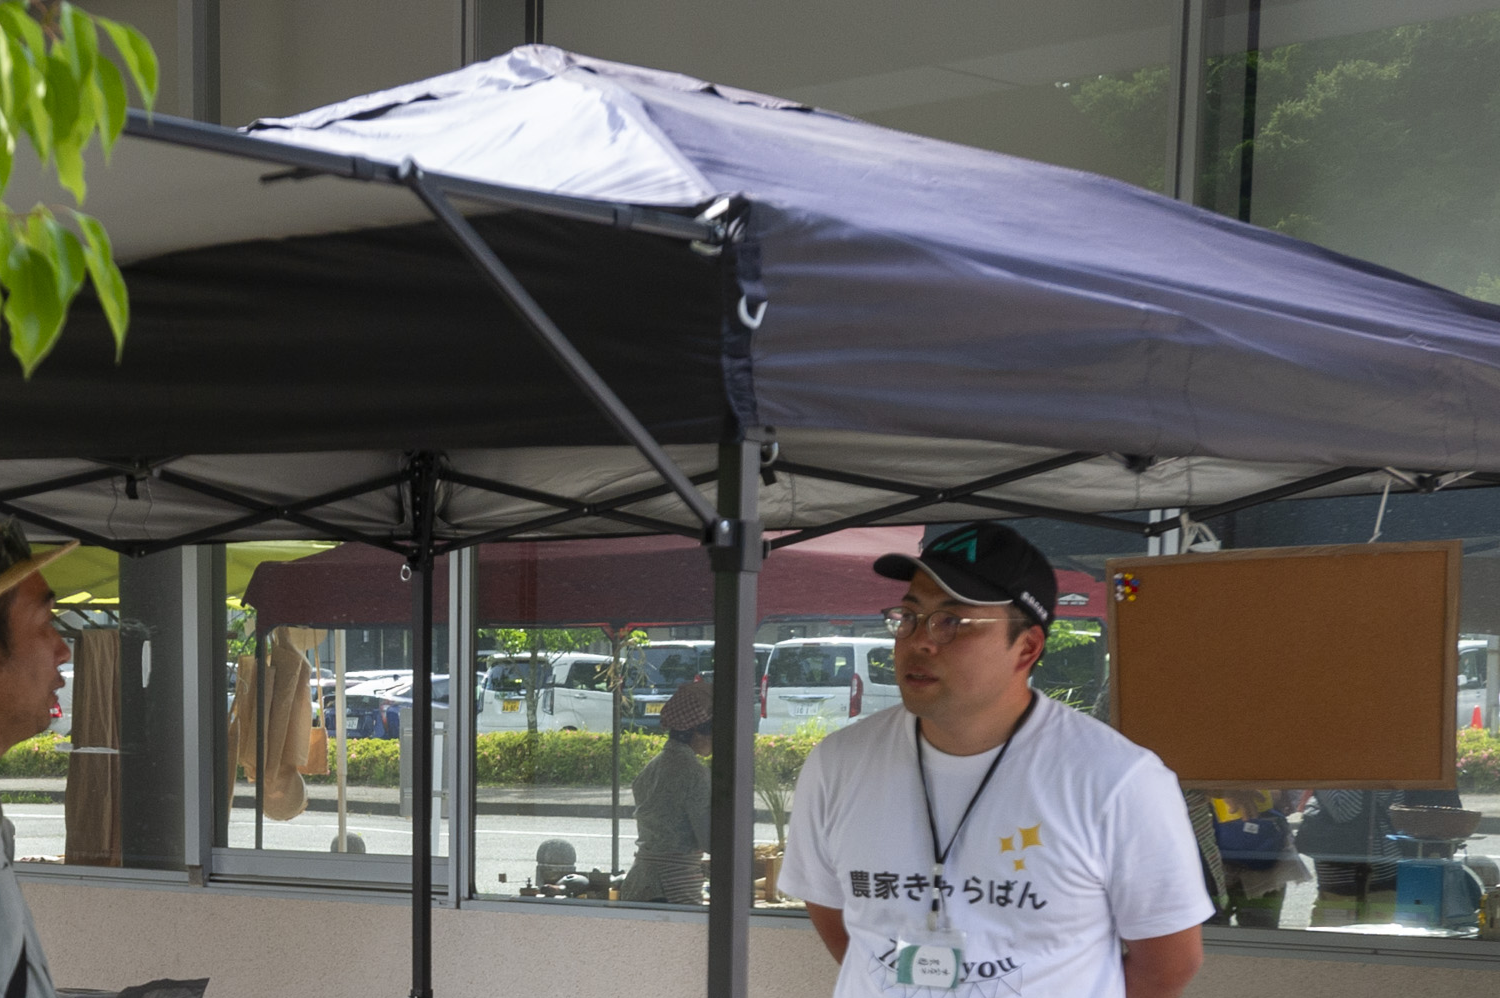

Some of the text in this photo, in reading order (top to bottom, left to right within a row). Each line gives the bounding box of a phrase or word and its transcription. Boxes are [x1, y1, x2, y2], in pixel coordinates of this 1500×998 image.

[850, 870, 1047, 910] 農家きゃらばん
[959, 956, 1018, 982] you
